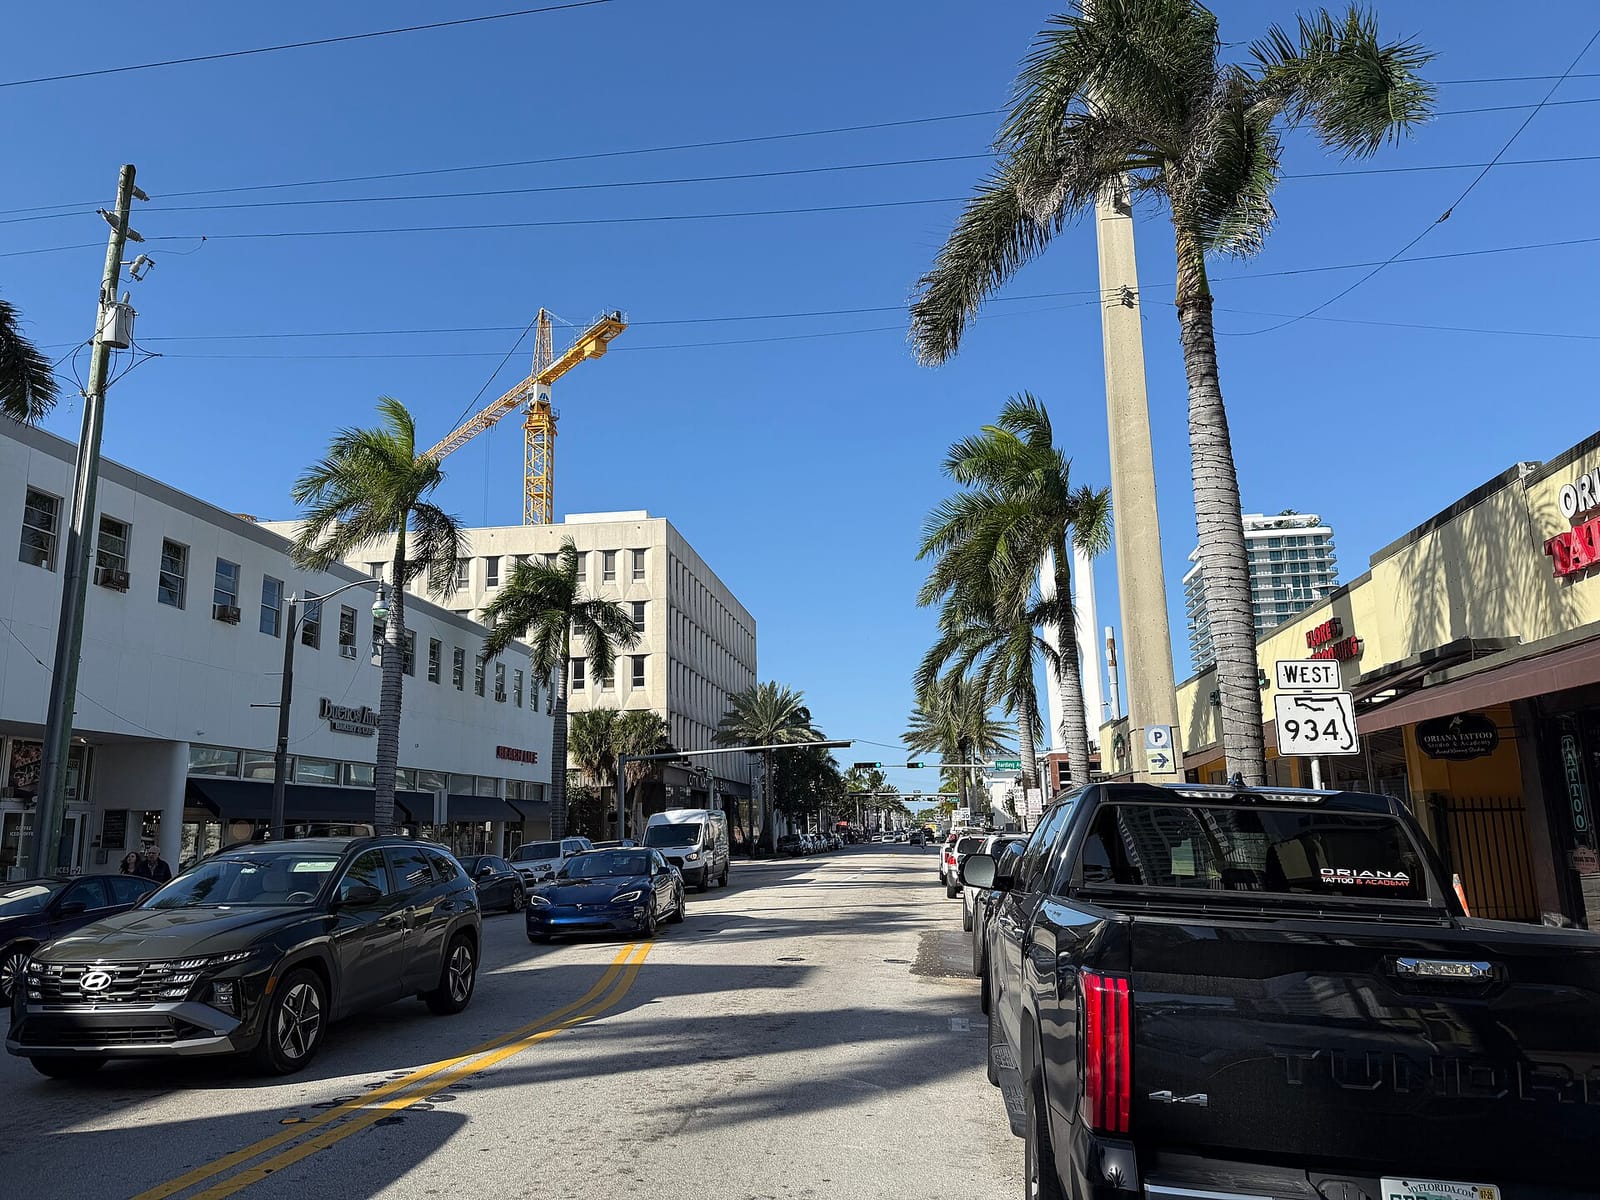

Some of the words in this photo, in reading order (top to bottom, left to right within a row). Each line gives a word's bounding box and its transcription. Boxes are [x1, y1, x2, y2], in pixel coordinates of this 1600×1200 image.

[1284, 665, 1331, 683] WEST
[1284, 719, 1338, 741] 934
[1154, 731, 1163, 742] P
[1424, 734, 1457, 742] ORIANA
[1459, 731, 1493, 741] TATTOO
[1563, 737, 1586, 829] TATTOO
[1320, 868, 1409, 879] ORIANA
[1321, 876, 1354, 884] TATTOO
[1365, 879, 1410, 887] ACADEMY
